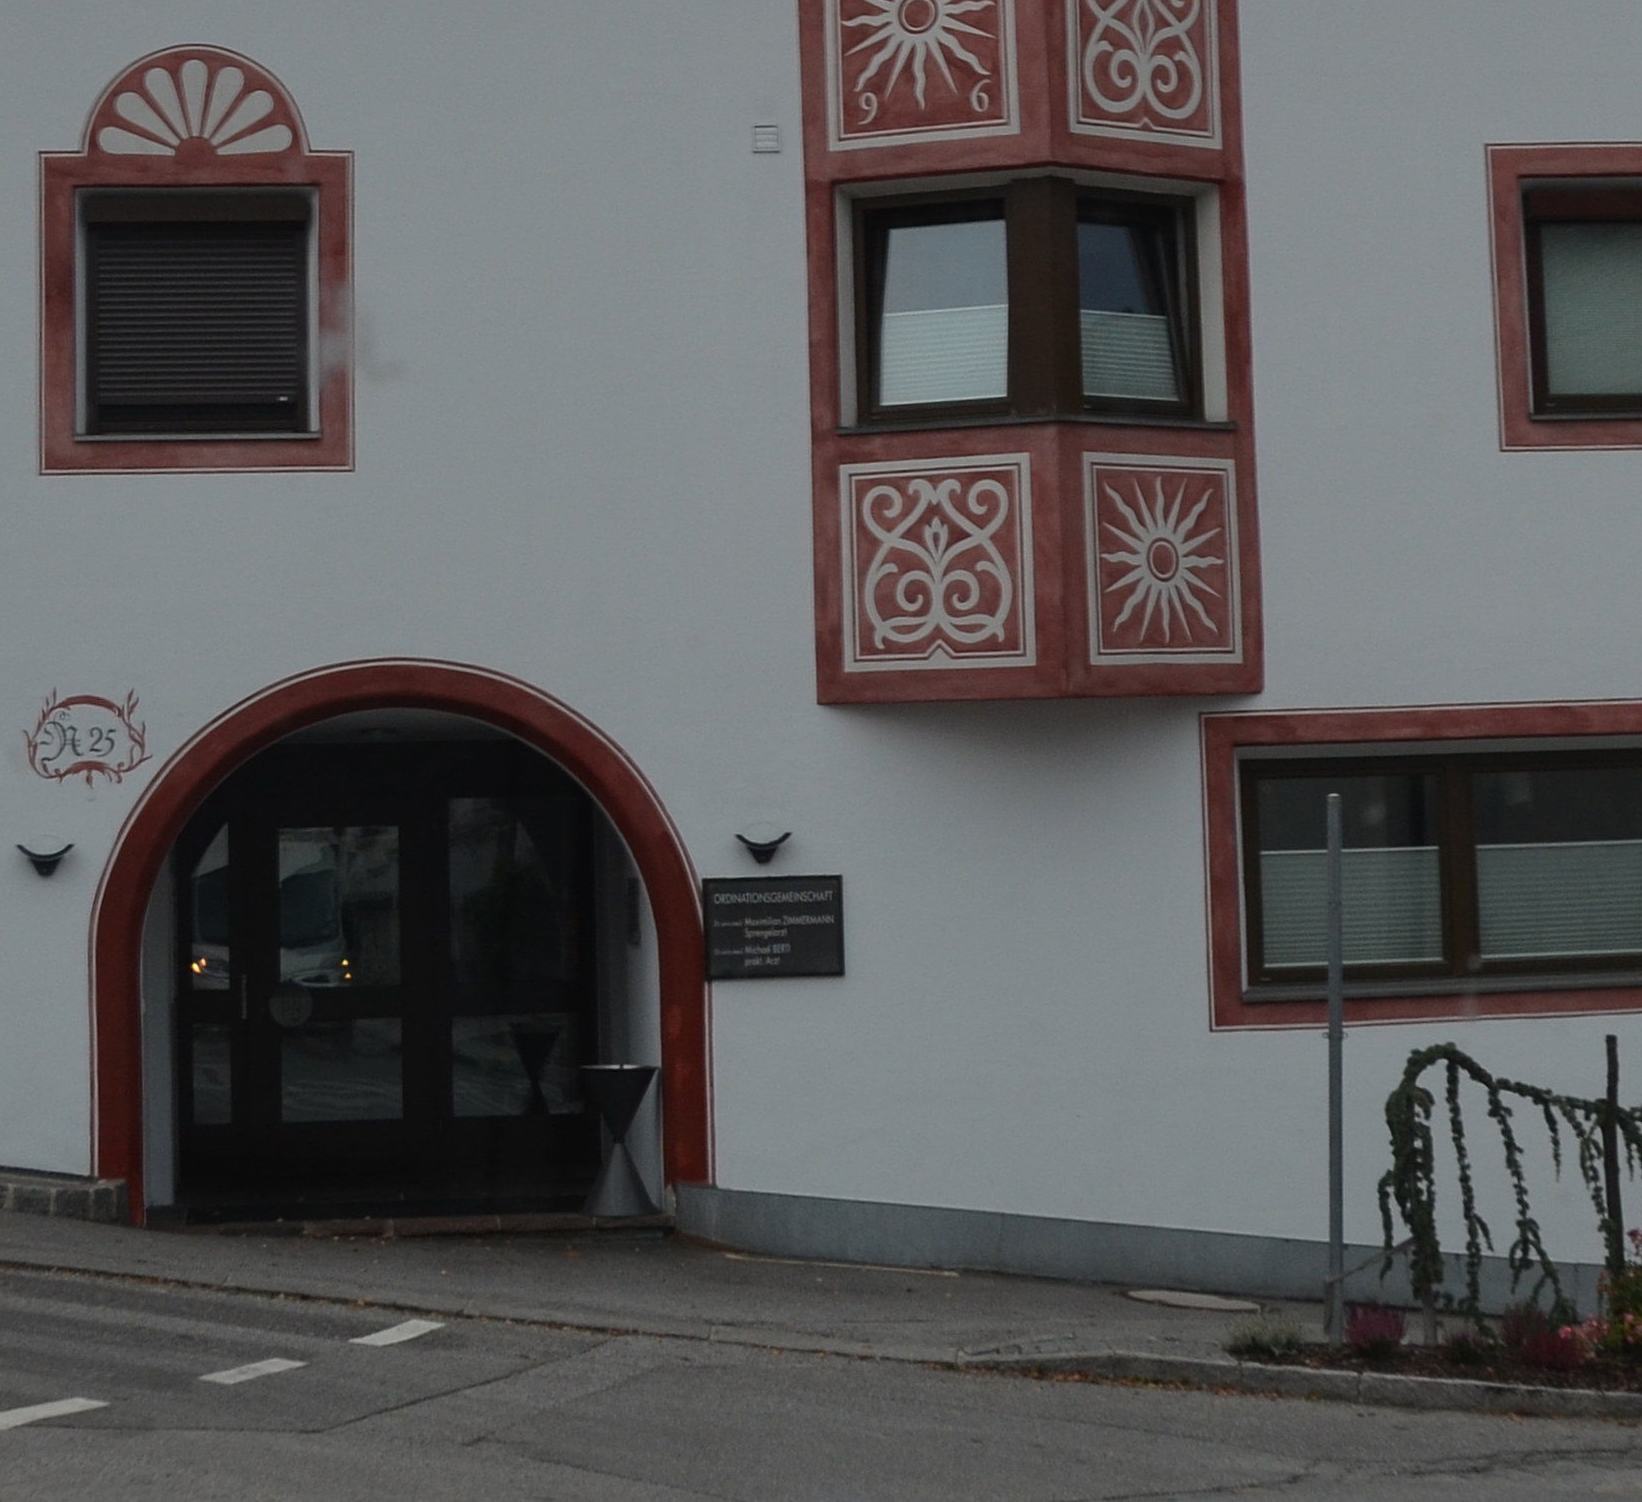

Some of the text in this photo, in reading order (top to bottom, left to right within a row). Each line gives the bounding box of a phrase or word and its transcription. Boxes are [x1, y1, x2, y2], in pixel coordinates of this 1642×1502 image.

[858, 92, 878, 126] 9
[969, 79, 992, 113] 6
[89, 726, 116, 758] 25
[713, 890, 834, 905] ORDINATIONSGEMEINSCHAFT
[782, 914, 835, 926] ZIMMERMANN
